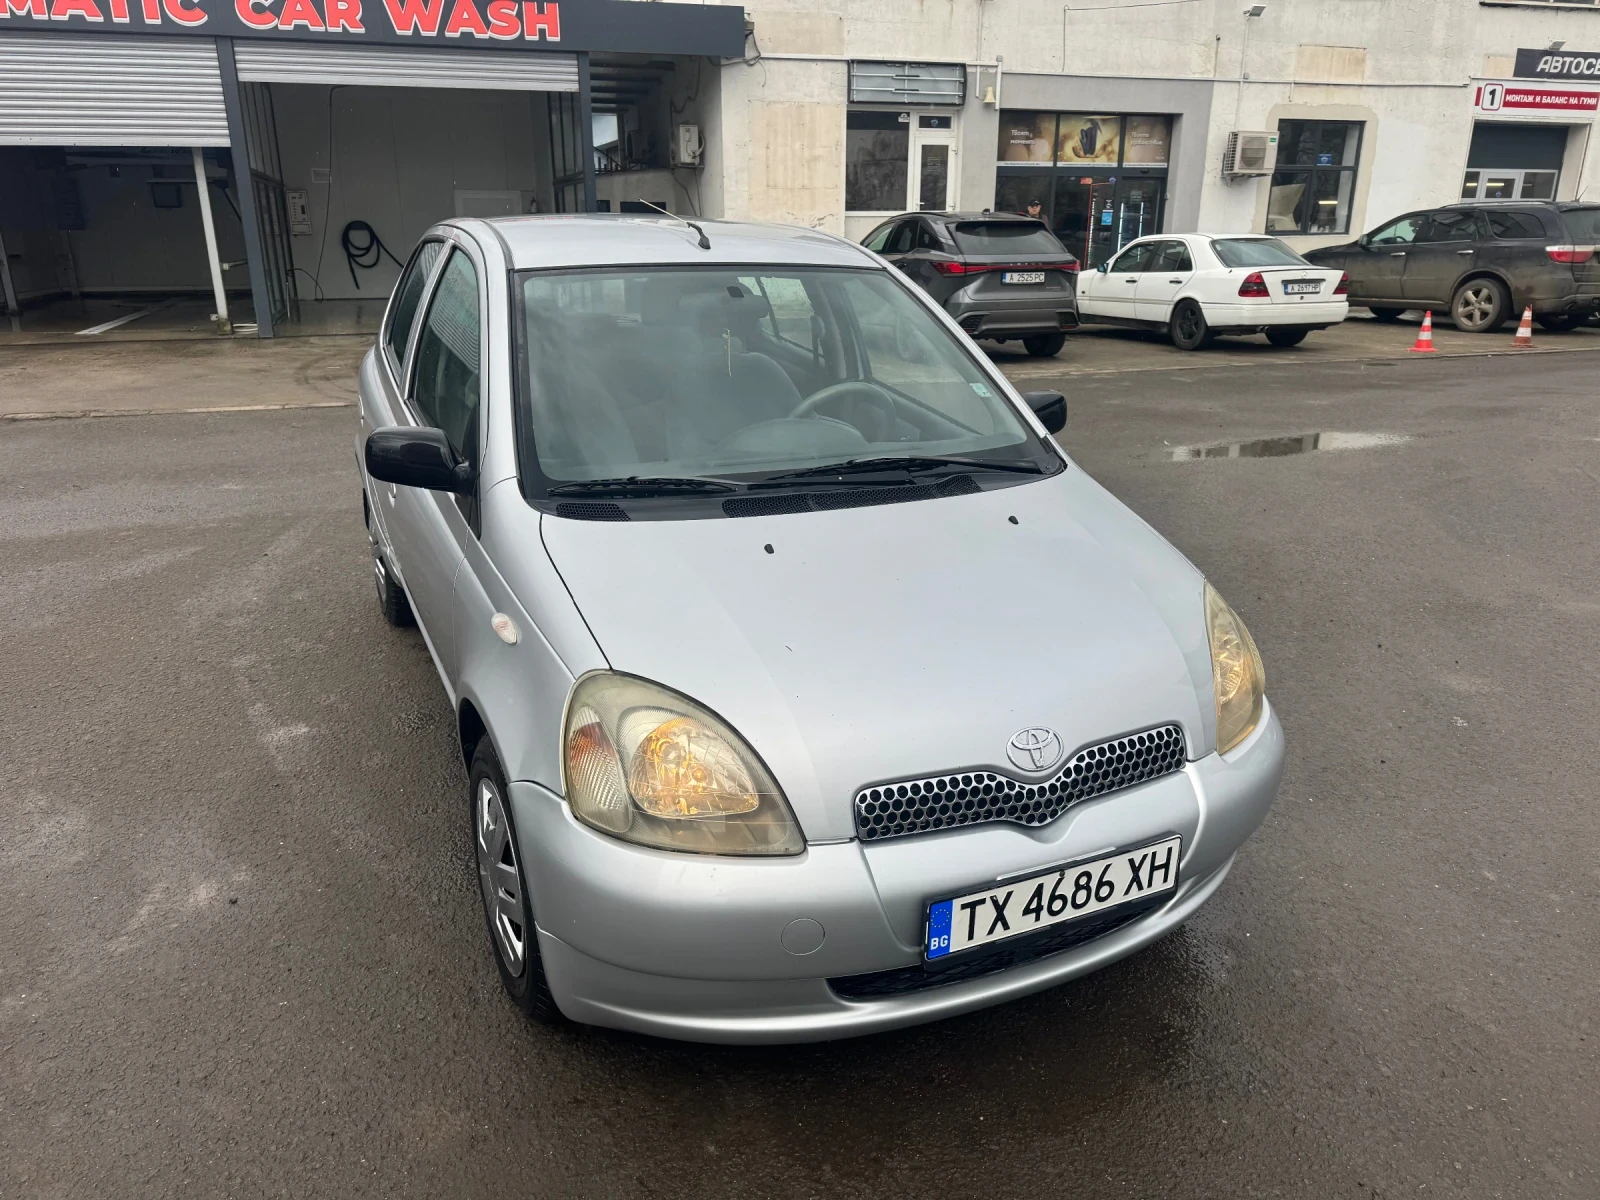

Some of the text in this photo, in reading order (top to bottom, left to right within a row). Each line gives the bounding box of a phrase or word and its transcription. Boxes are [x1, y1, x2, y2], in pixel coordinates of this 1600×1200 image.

[235, 0, 365, 33] CAR
[382, 0, 560, 41] WASH
[1488, 88, 1496, 106] 1
[1505, 94, 1534, 103] МОНТАЖ
[1541, 96, 1568, 104] БАЛАНС
[1569, 97, 1578, 105] НА
[1579, 97, 1598, 105] ГУМИ
[960, 846, 1173, 942] TX 4686 XH
[930, 934, 949, 950] BG
